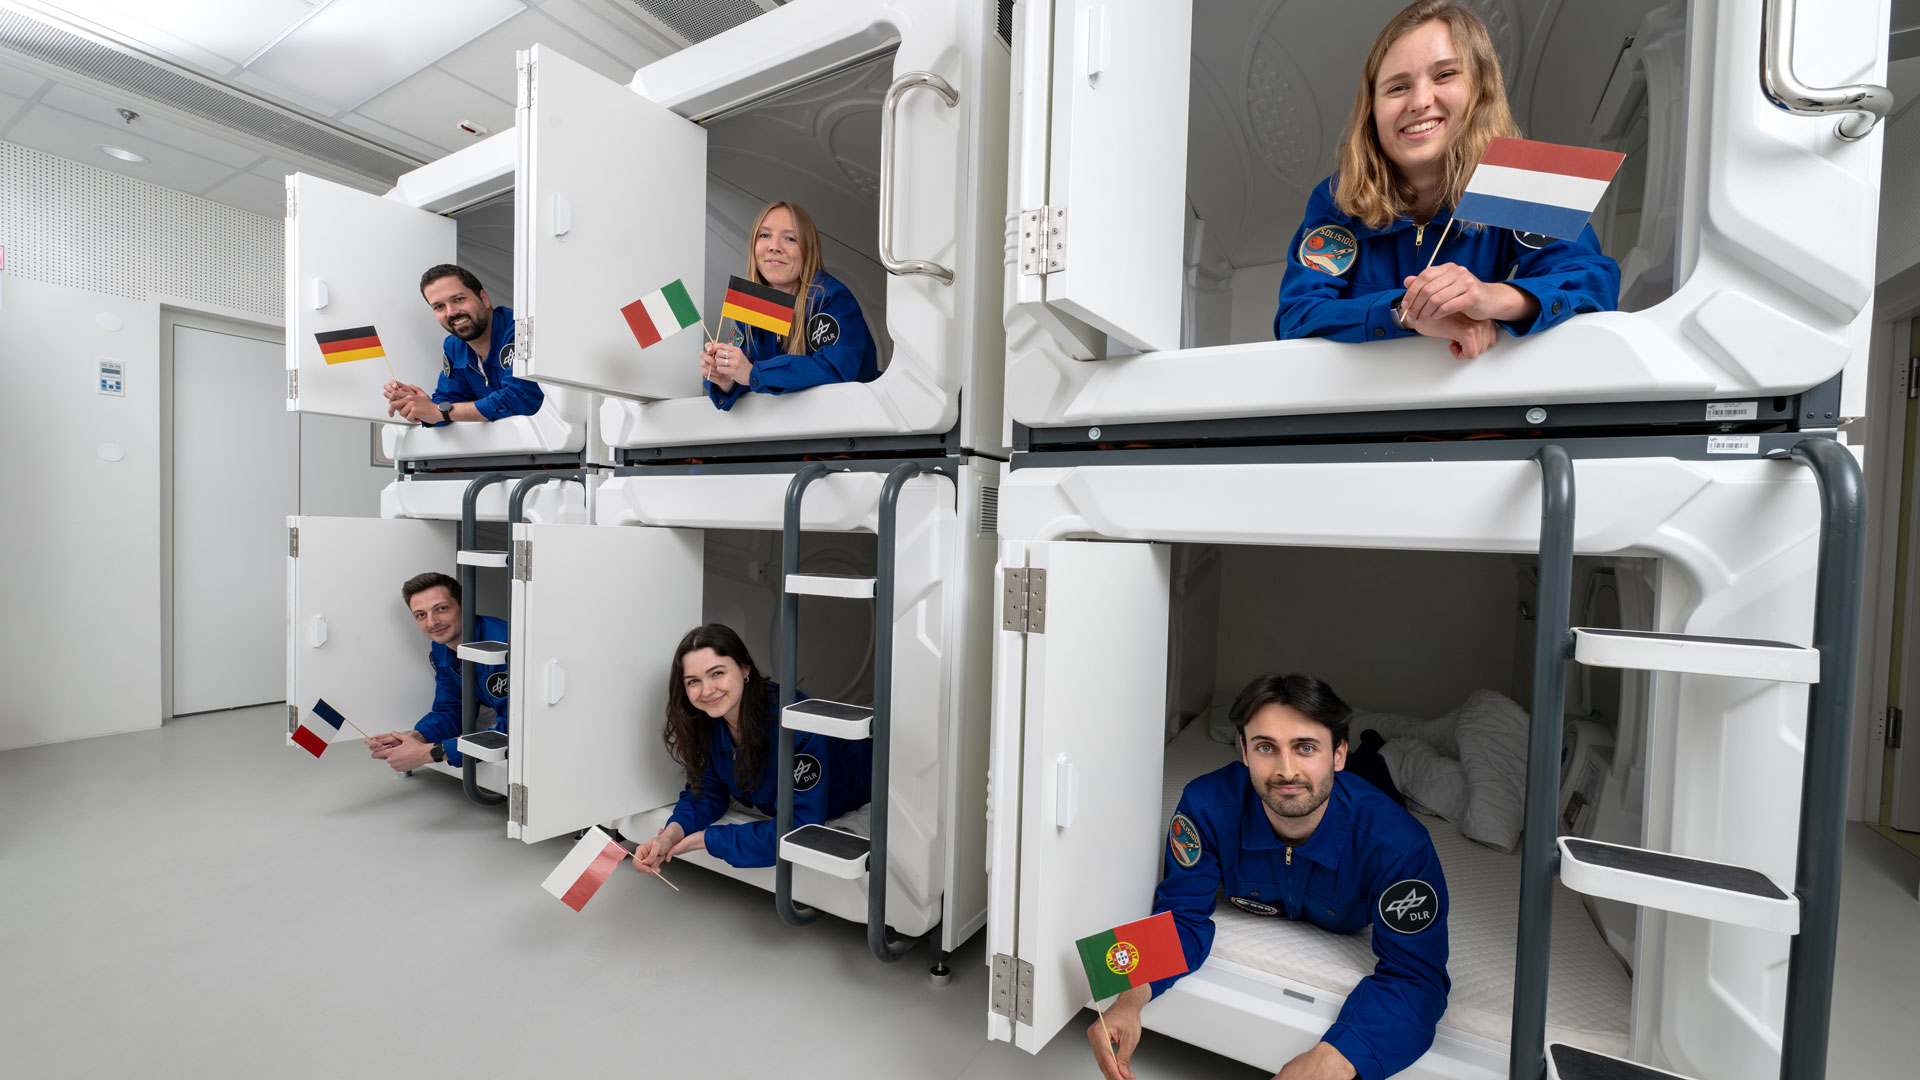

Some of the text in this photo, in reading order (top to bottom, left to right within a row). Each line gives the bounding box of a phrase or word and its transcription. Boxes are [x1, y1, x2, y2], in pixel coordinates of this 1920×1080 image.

[1319, 228, 1355, 247] SOLIS100
[822, 333, 836, 342] DLR
[803, 772, 818, 782] DLR
[1409, 910, 1430, 921] DLR
